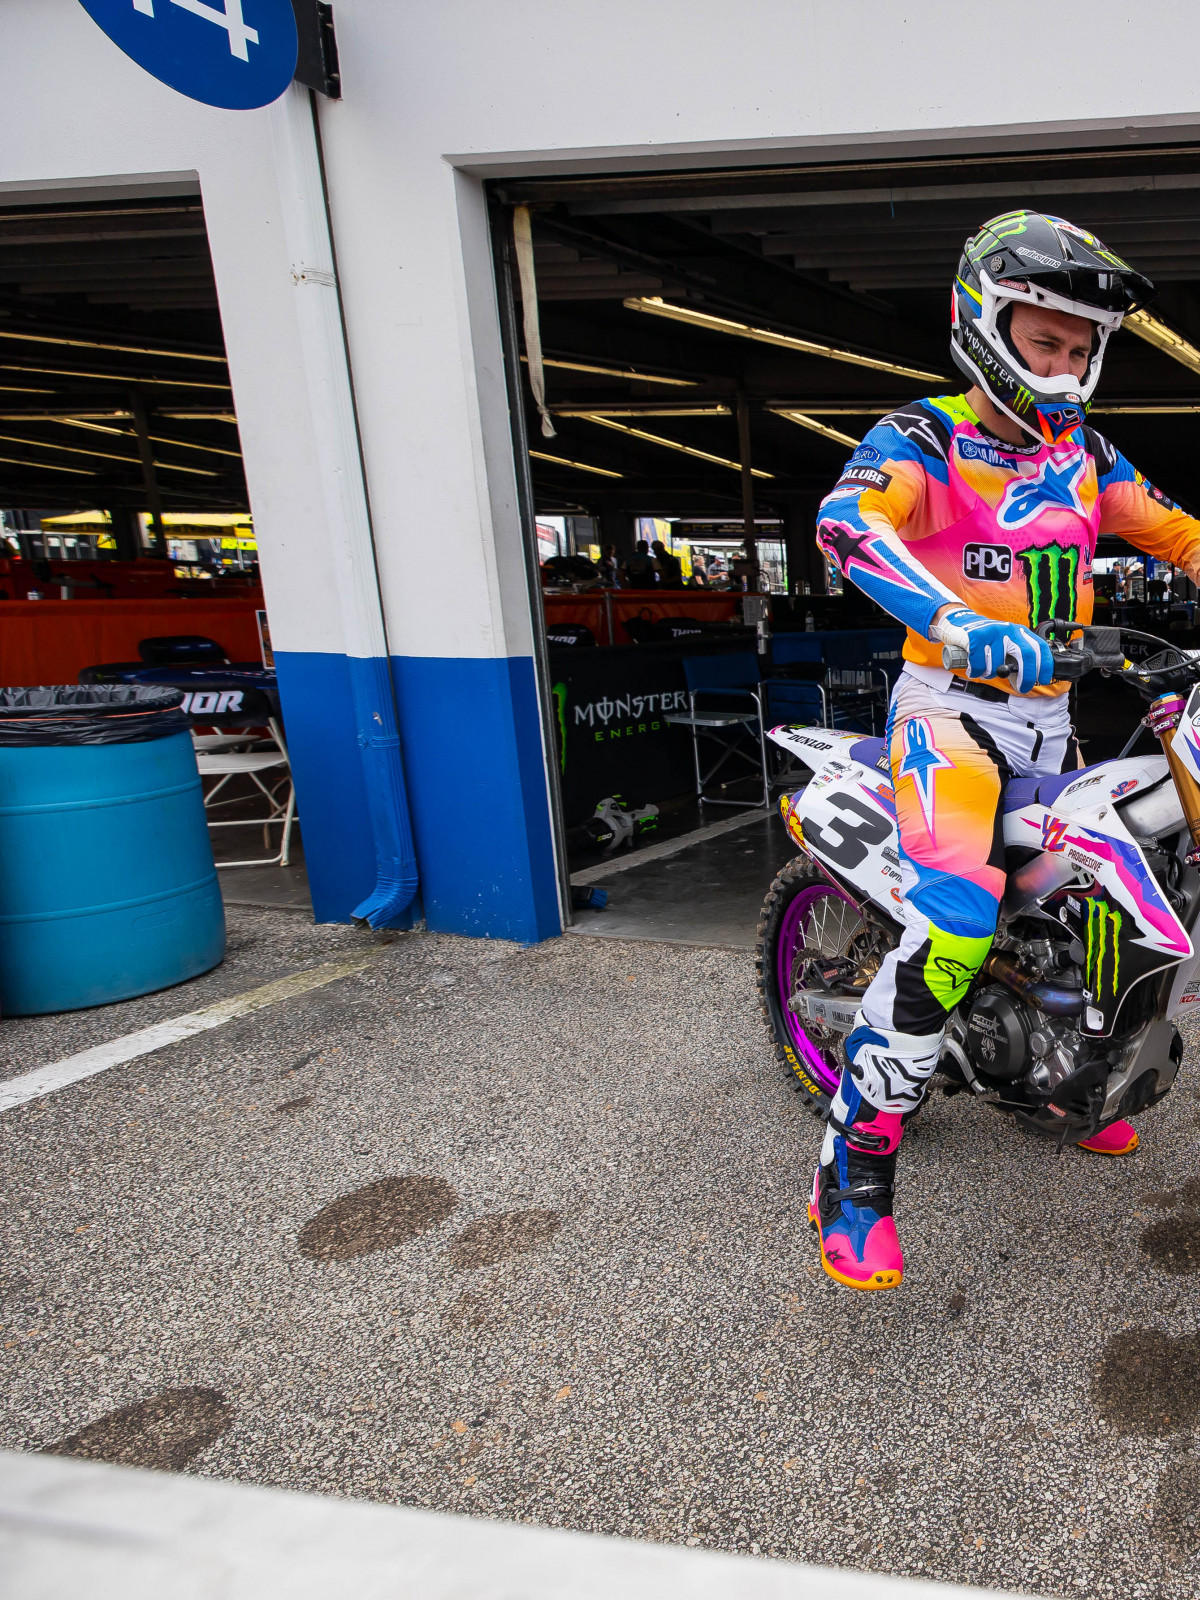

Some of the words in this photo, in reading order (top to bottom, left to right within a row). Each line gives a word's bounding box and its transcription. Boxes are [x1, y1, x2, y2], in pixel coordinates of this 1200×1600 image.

[965, 547, 1011, 577] PPG
[574, 690, 688, 727] MONSTER
[787, 734, 834, 751] DUNLOP
[801, 791, 894, 870] 3
[1067, 847, 1103, 873] PROGRESSIVE
[784, 1045, 820, 1096] DUNLOP
